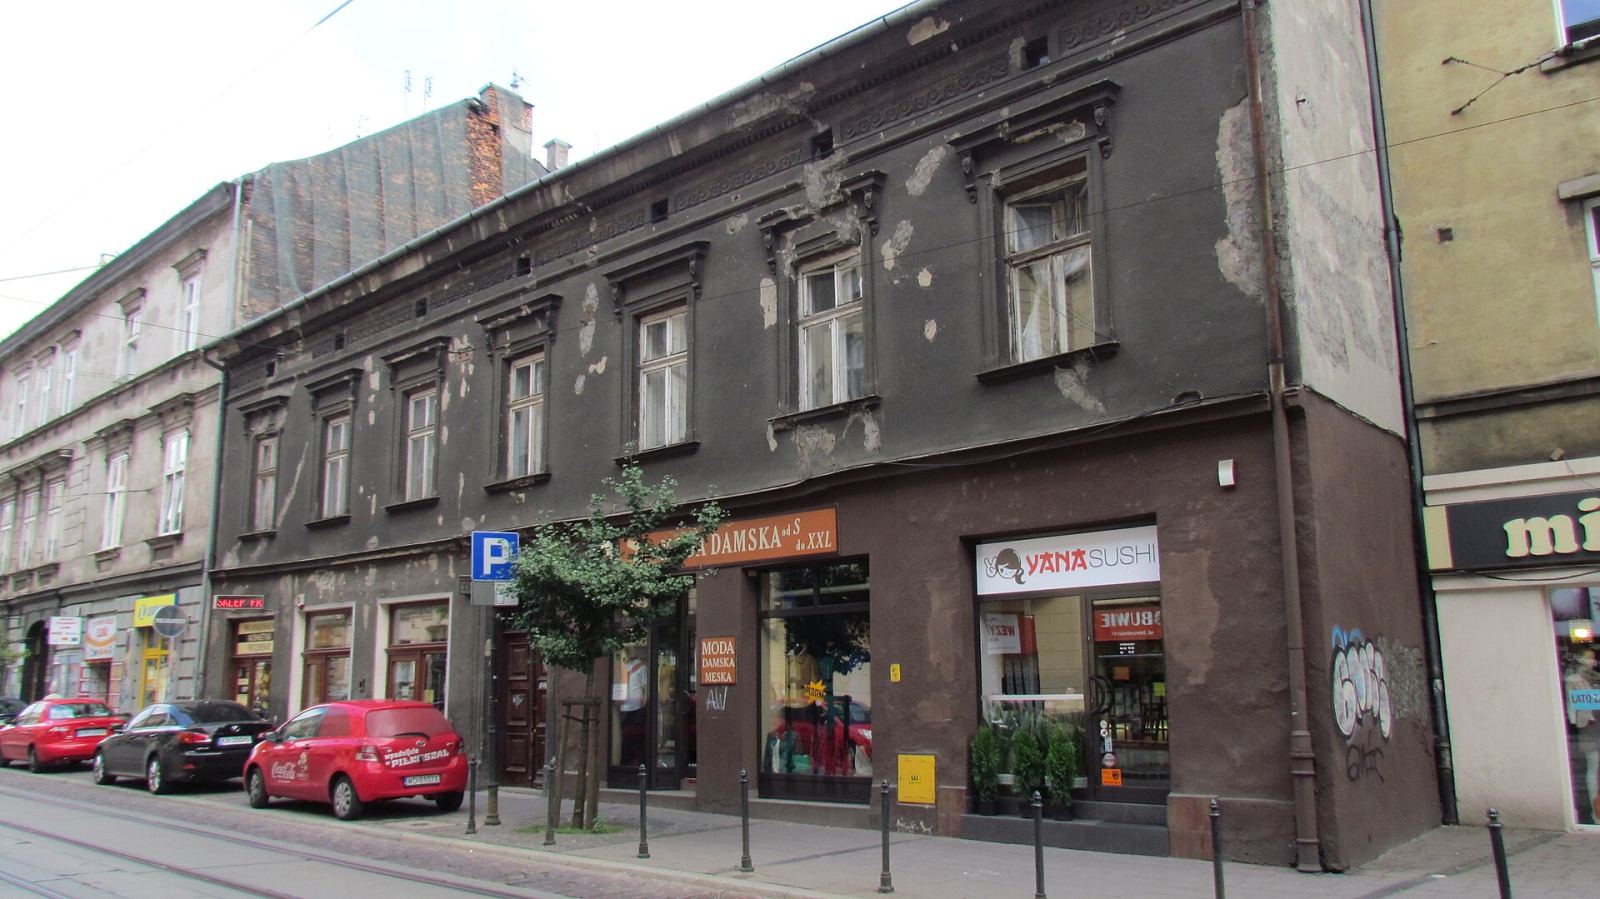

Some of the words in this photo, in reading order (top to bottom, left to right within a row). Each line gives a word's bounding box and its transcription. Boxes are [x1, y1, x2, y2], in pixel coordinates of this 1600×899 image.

[711, 525, 782, 556] DAMSKA
[782, 524, 790, 536] od
[793, 518, 800, 535] S
[796, 539, 805, 551] do
[807, 530, 831, 549] XXL
[484, 537, 509, 574] P
[1026, 549, 1088, 577] YANA
[1089, 544, 1156, 569] SUSHI
[702, 641, 735, 655] MODA
[702, 657, 735, 669] DAMSKA
